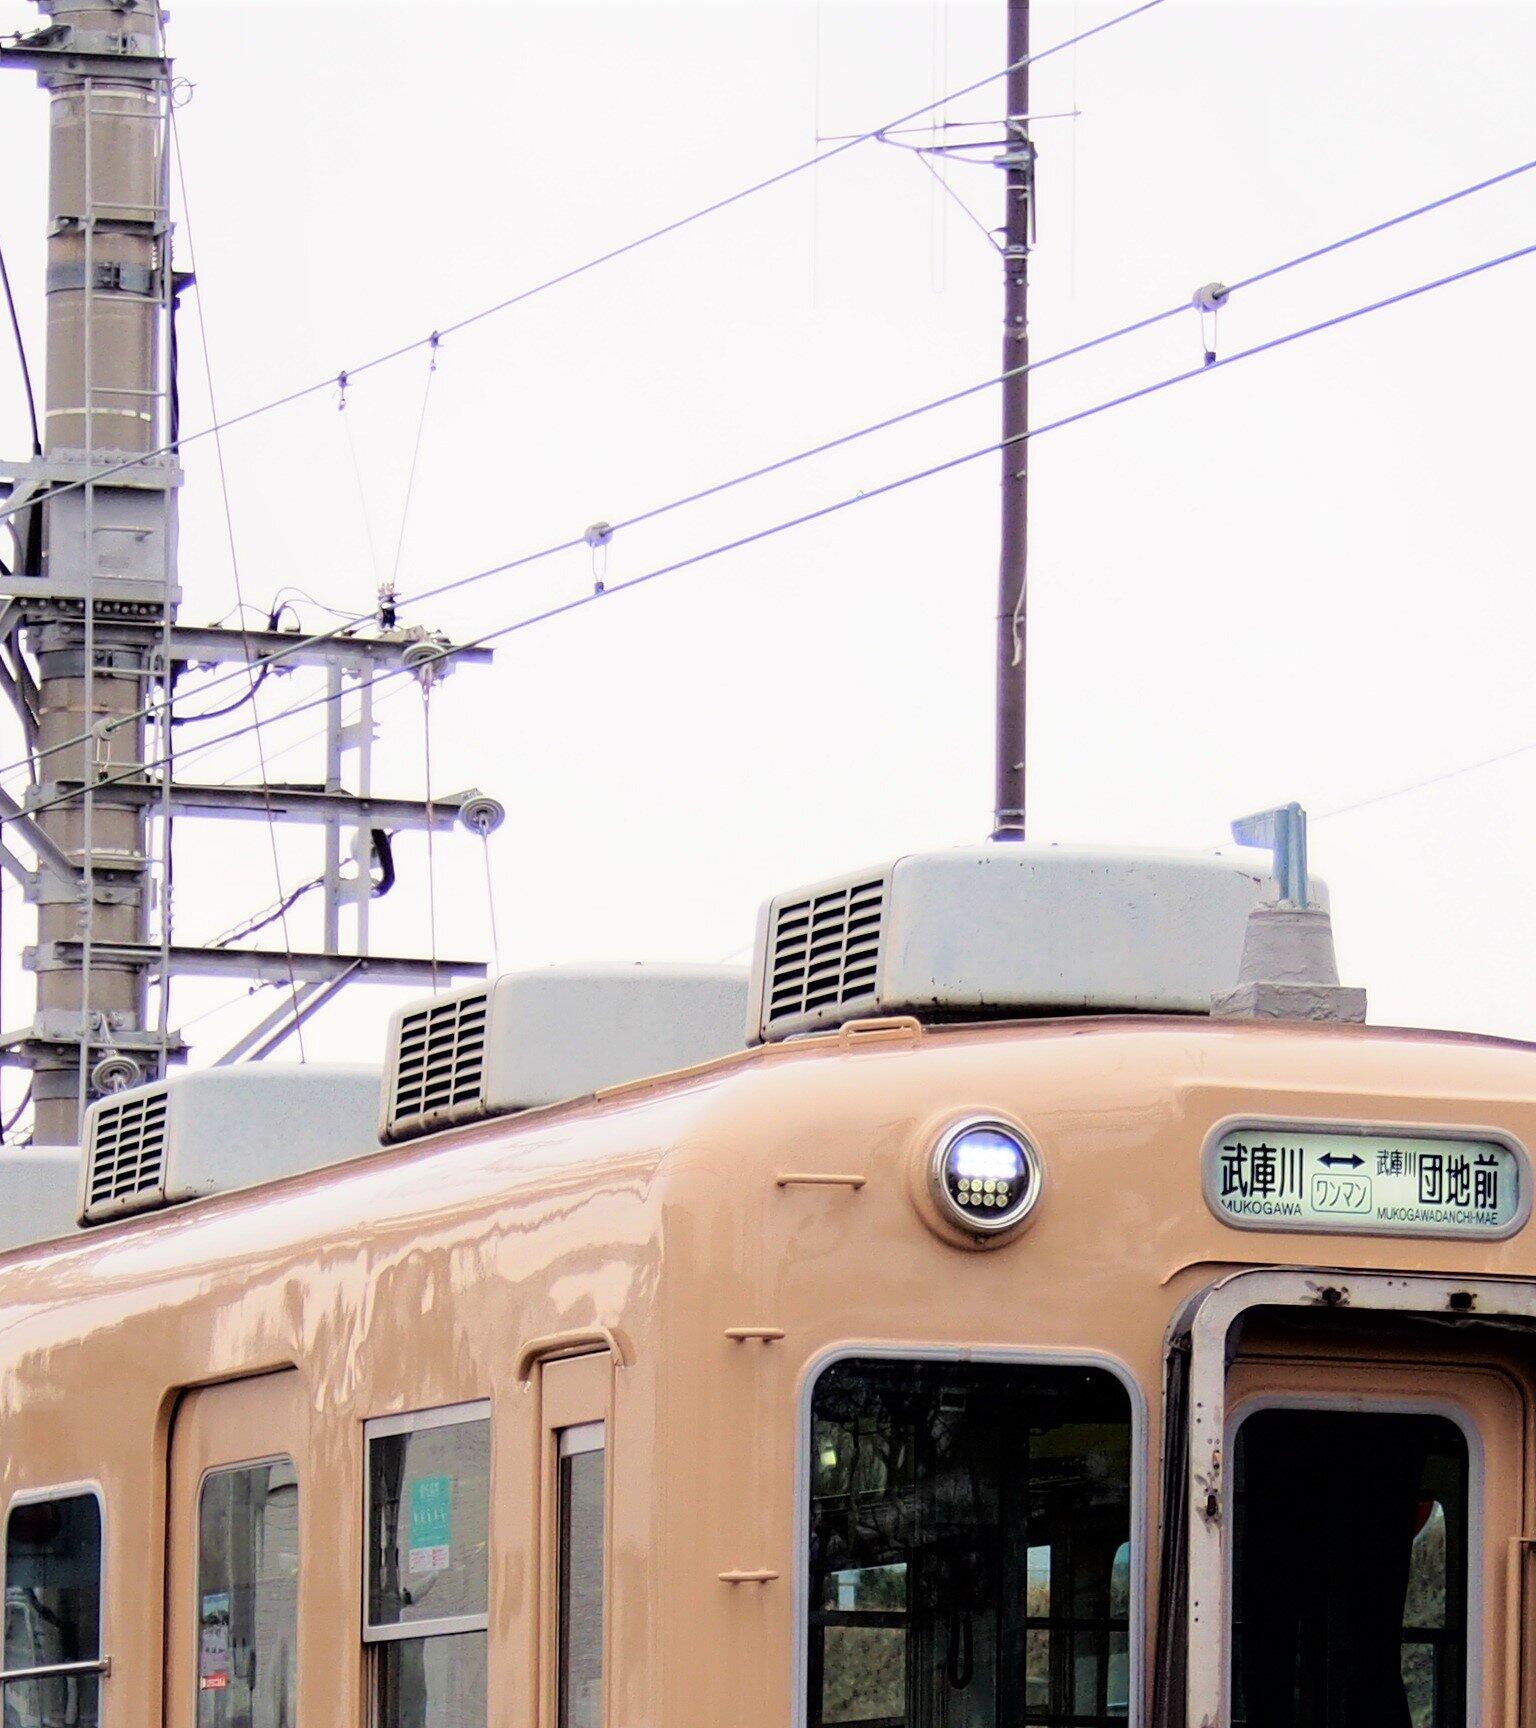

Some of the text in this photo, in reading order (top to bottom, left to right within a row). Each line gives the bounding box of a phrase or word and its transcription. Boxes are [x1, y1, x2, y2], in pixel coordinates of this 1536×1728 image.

[1221, 1142, 1499, 1210] 武庫川 武庫川団地前
[1316, 1179, 1367, 1209] ワンマン
[1221, 1199, 1498, 1226] MUKOGAWA MUKOGAWADANCHI-MAE
